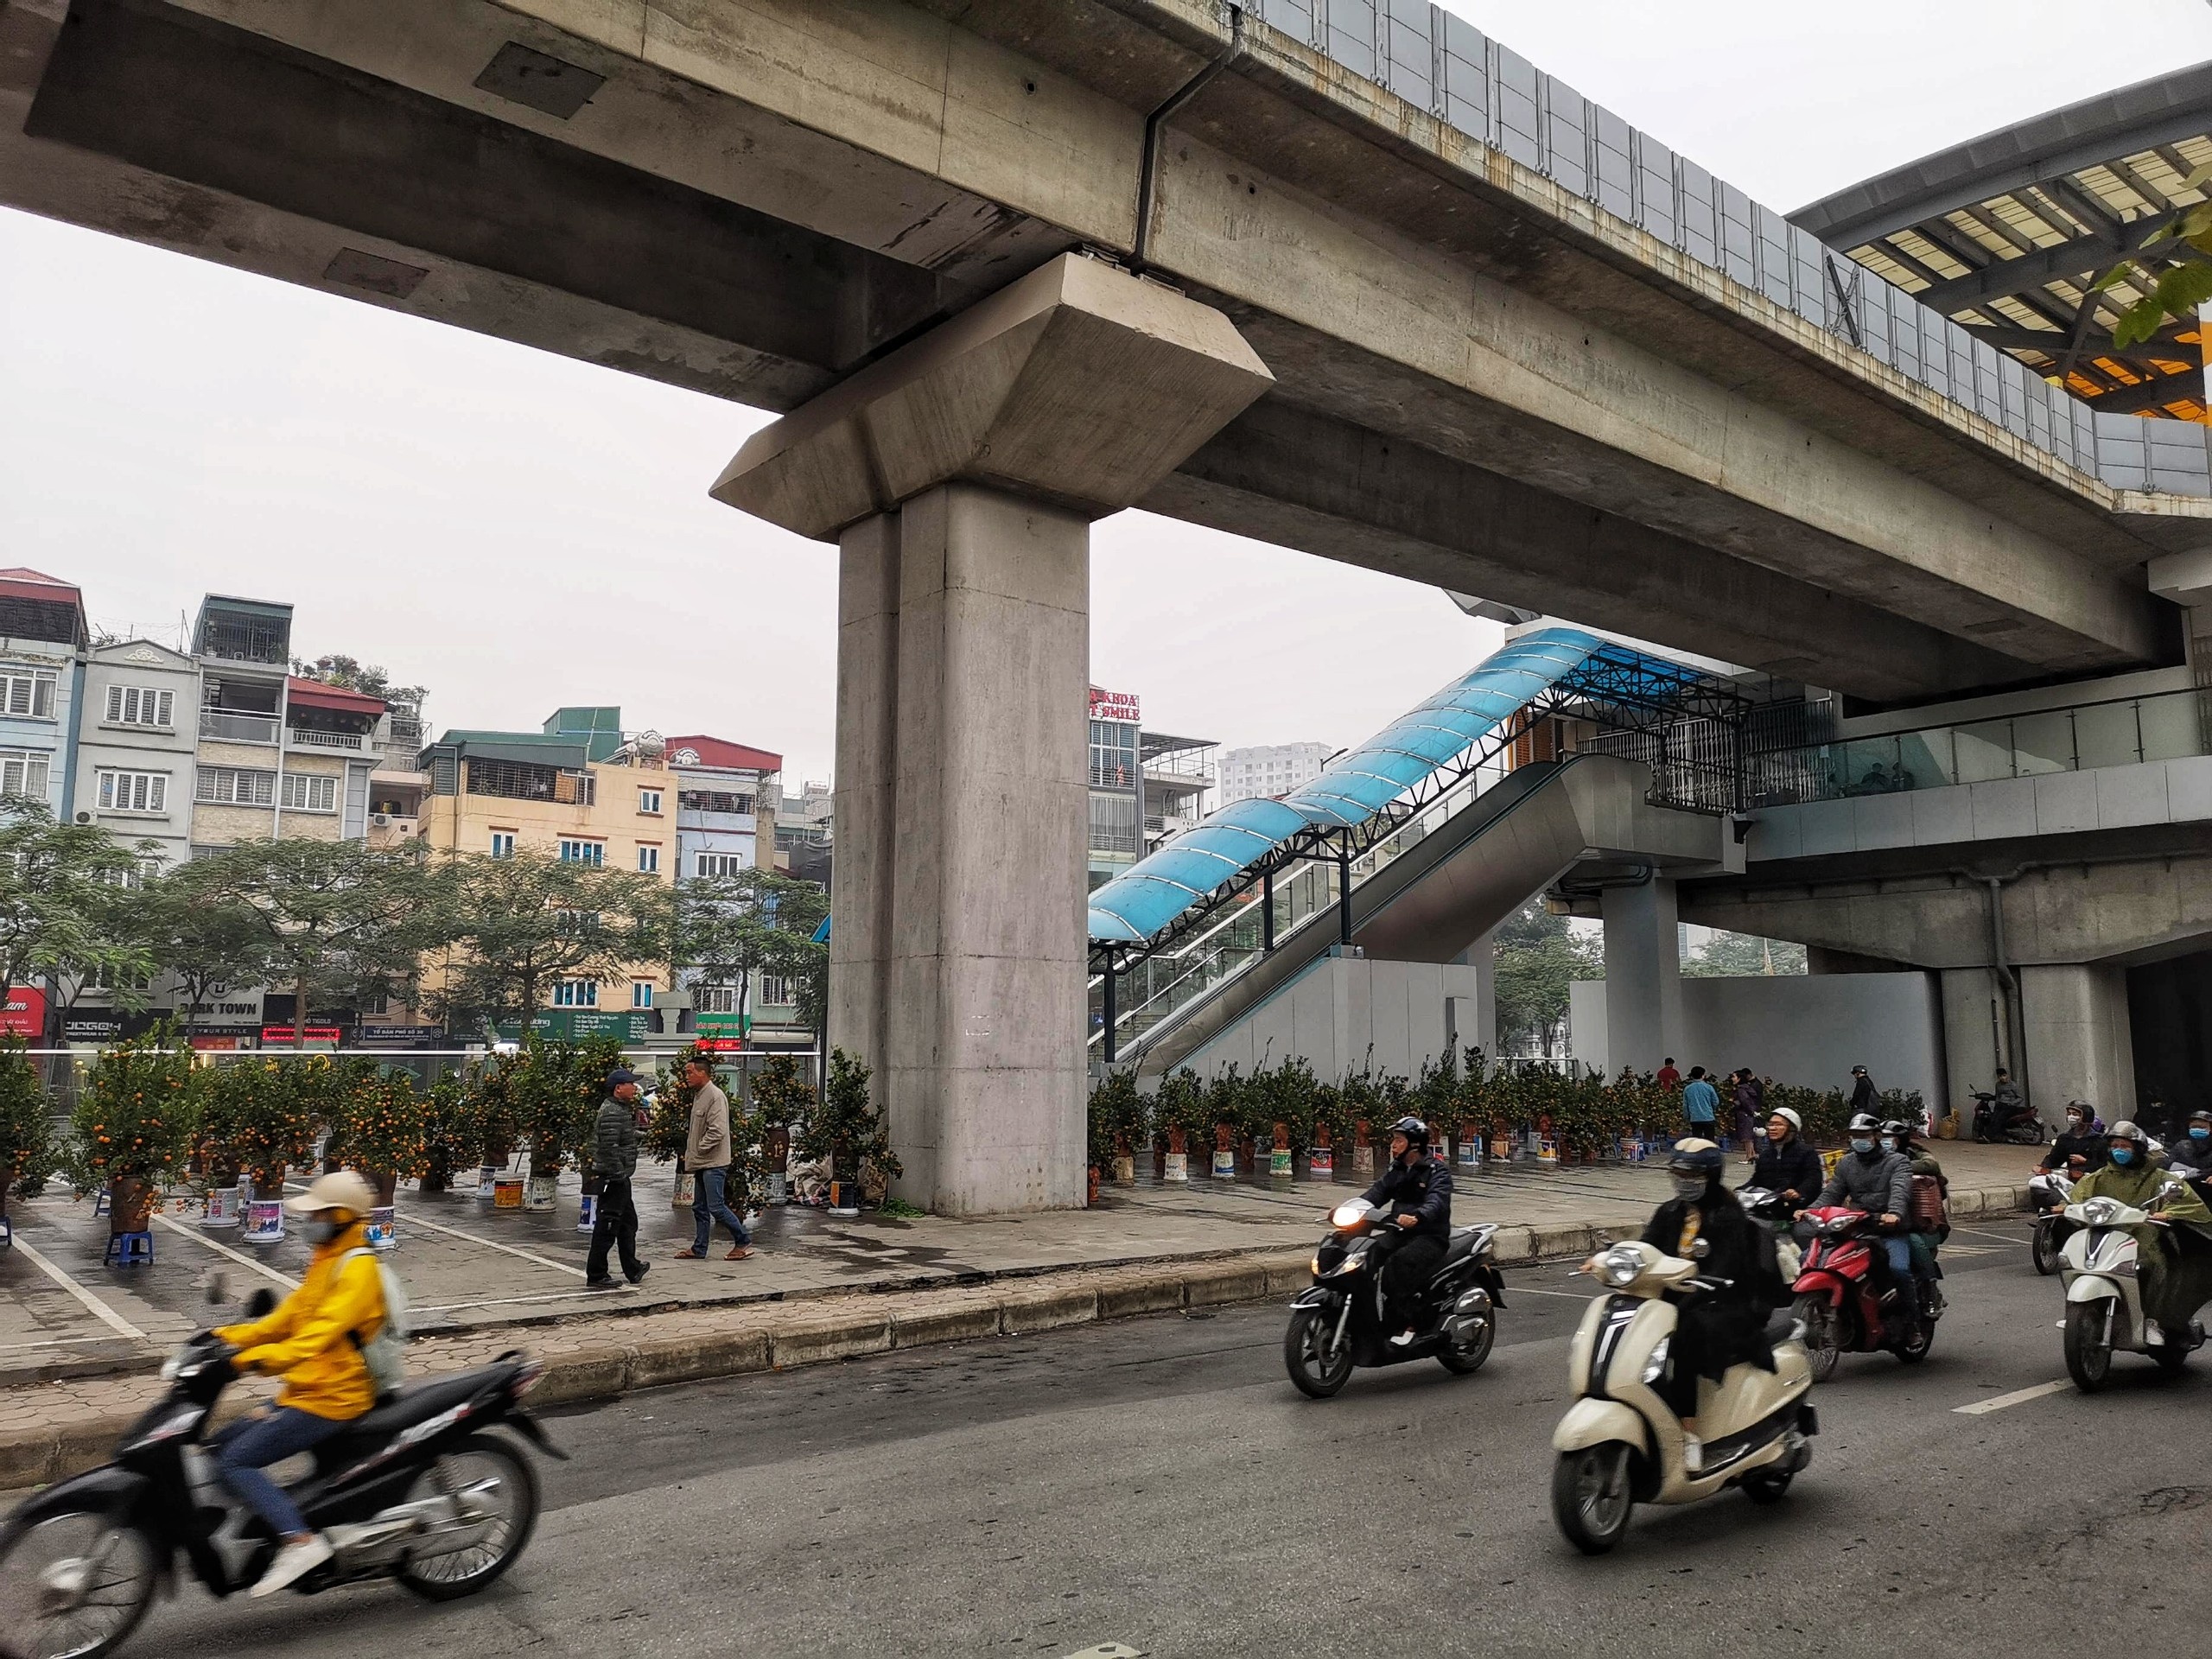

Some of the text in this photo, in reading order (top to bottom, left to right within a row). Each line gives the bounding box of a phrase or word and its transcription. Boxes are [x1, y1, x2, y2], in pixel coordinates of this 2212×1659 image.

[1103, 692, 1136, 706] KHOA
[1103, 706, 1140, 720] SMILE
[219, 1003, 257, 1015] TOWN
